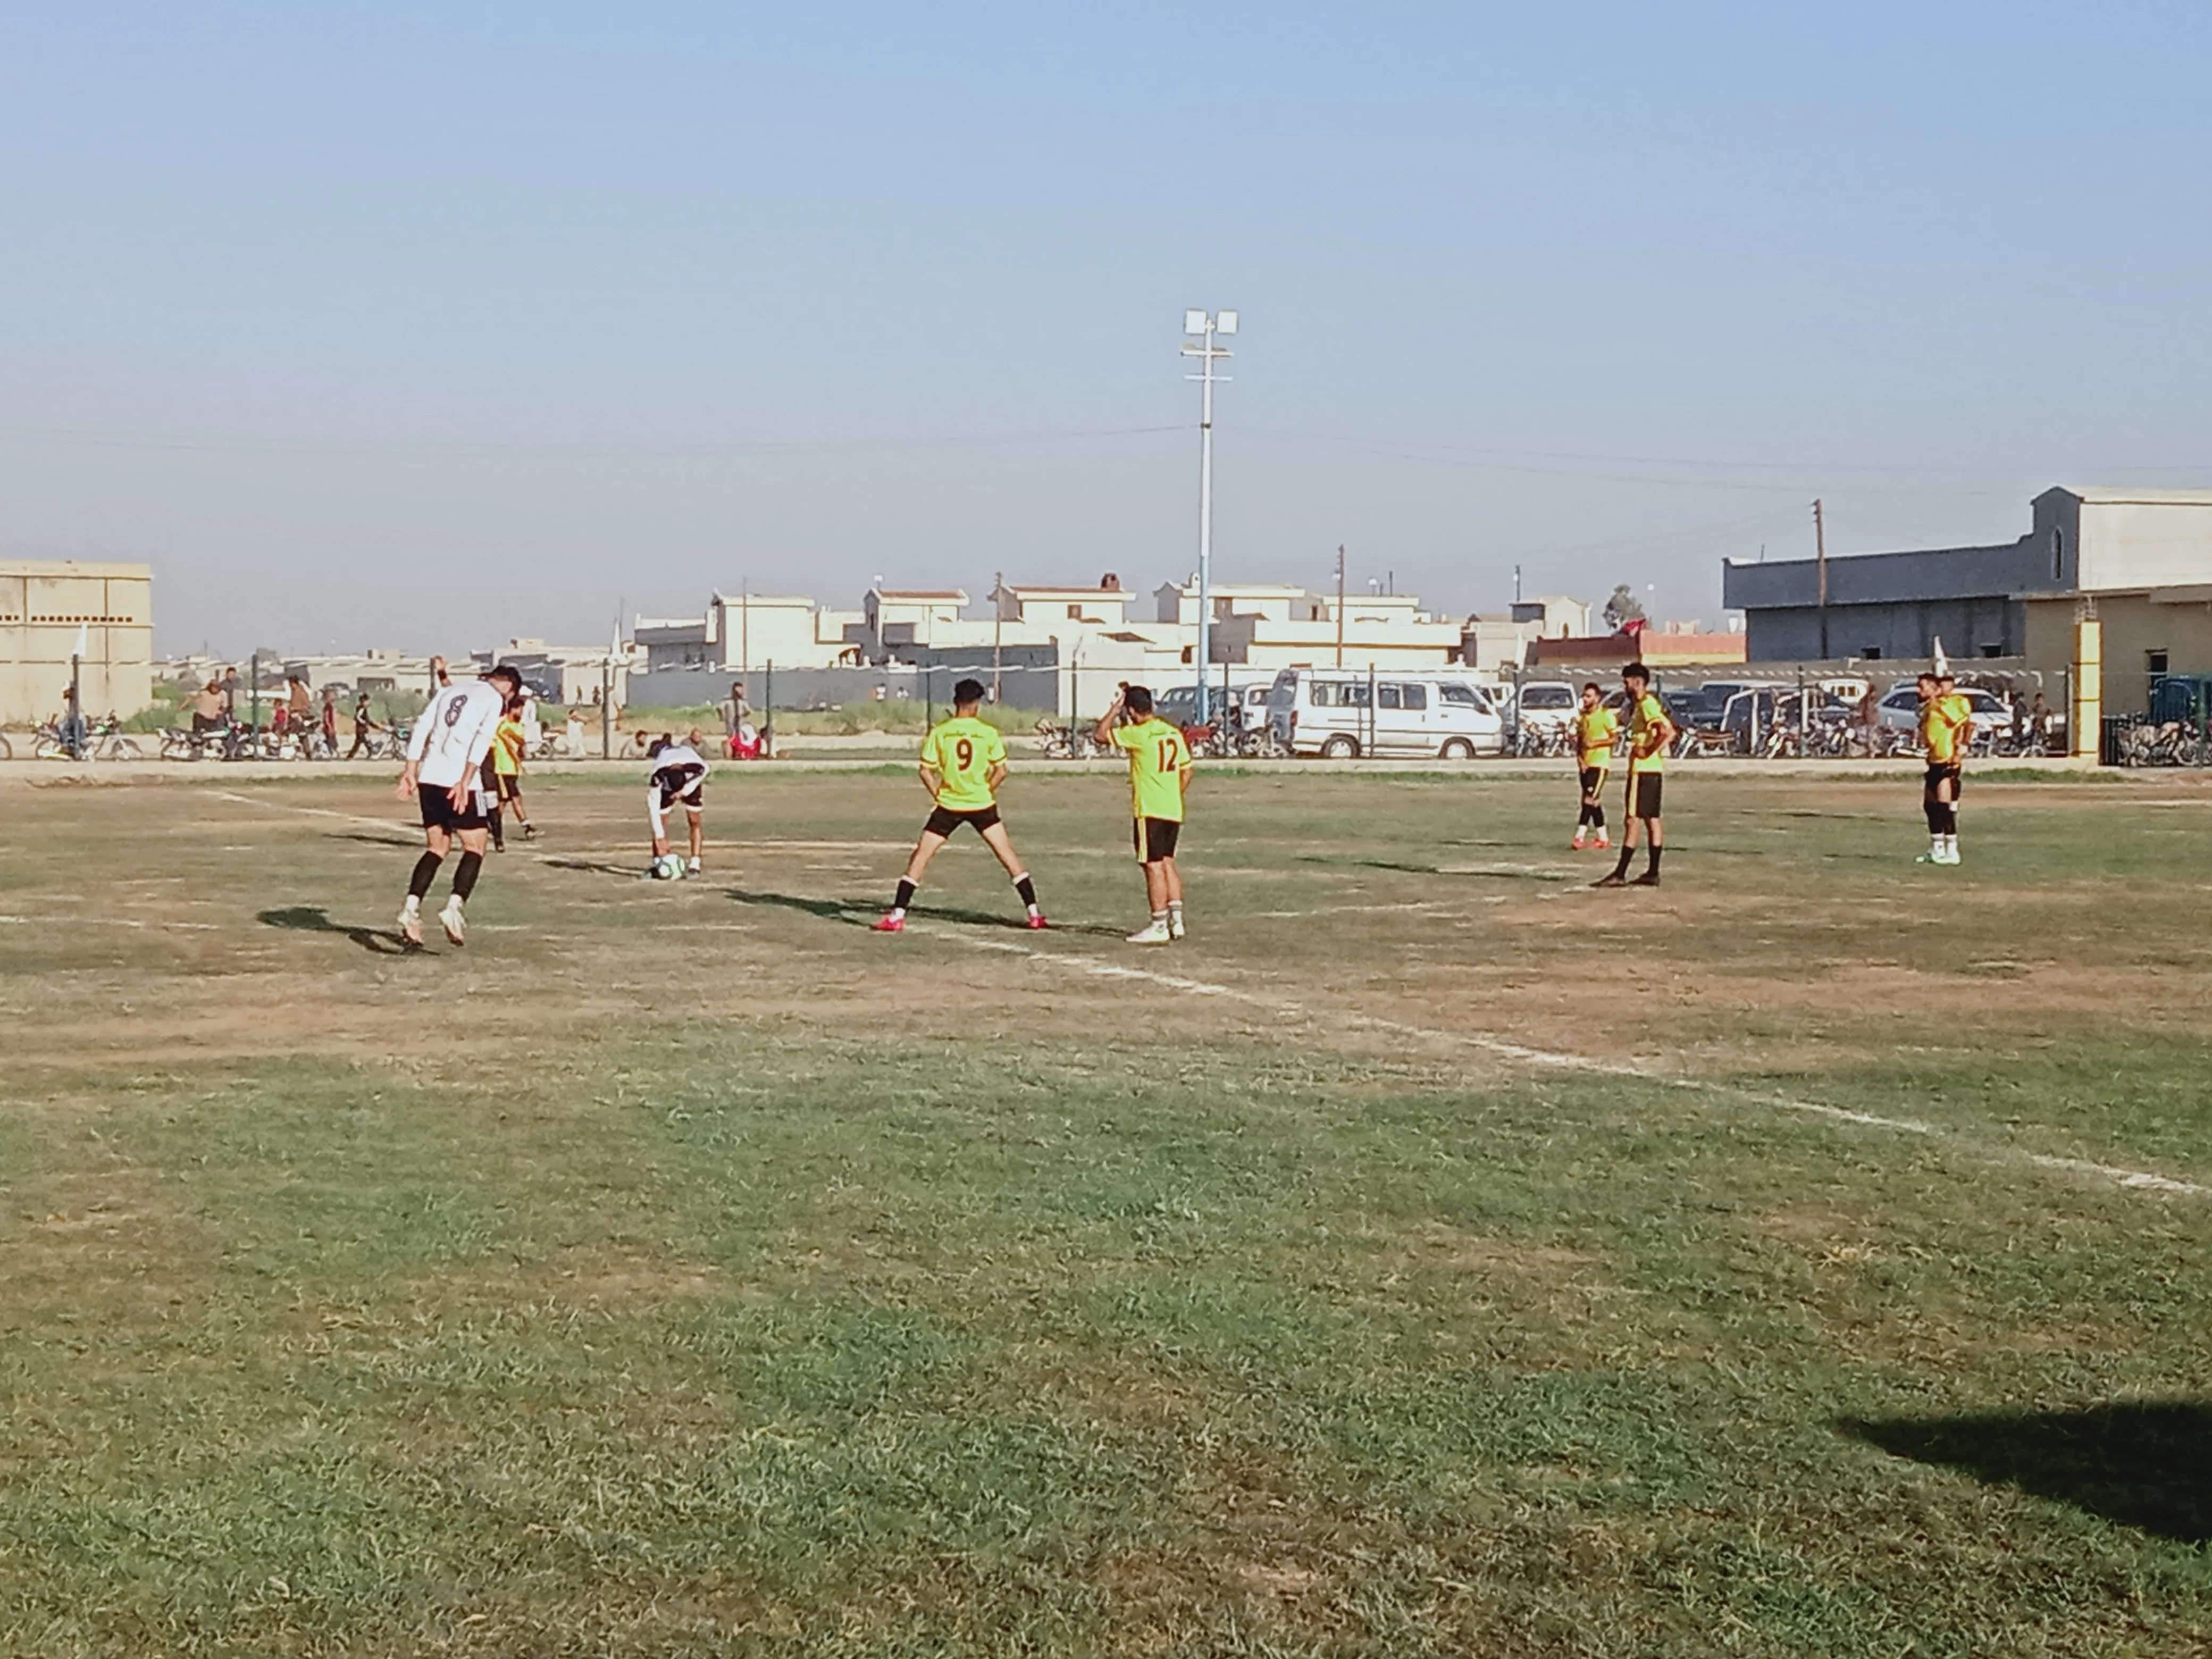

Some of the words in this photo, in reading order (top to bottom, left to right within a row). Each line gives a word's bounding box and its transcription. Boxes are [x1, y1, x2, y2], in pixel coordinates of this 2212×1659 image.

[445, 694, 468, 727] 8
[957, 739, 973, 772] 9
[1158, 738, 1178, 773] 12
